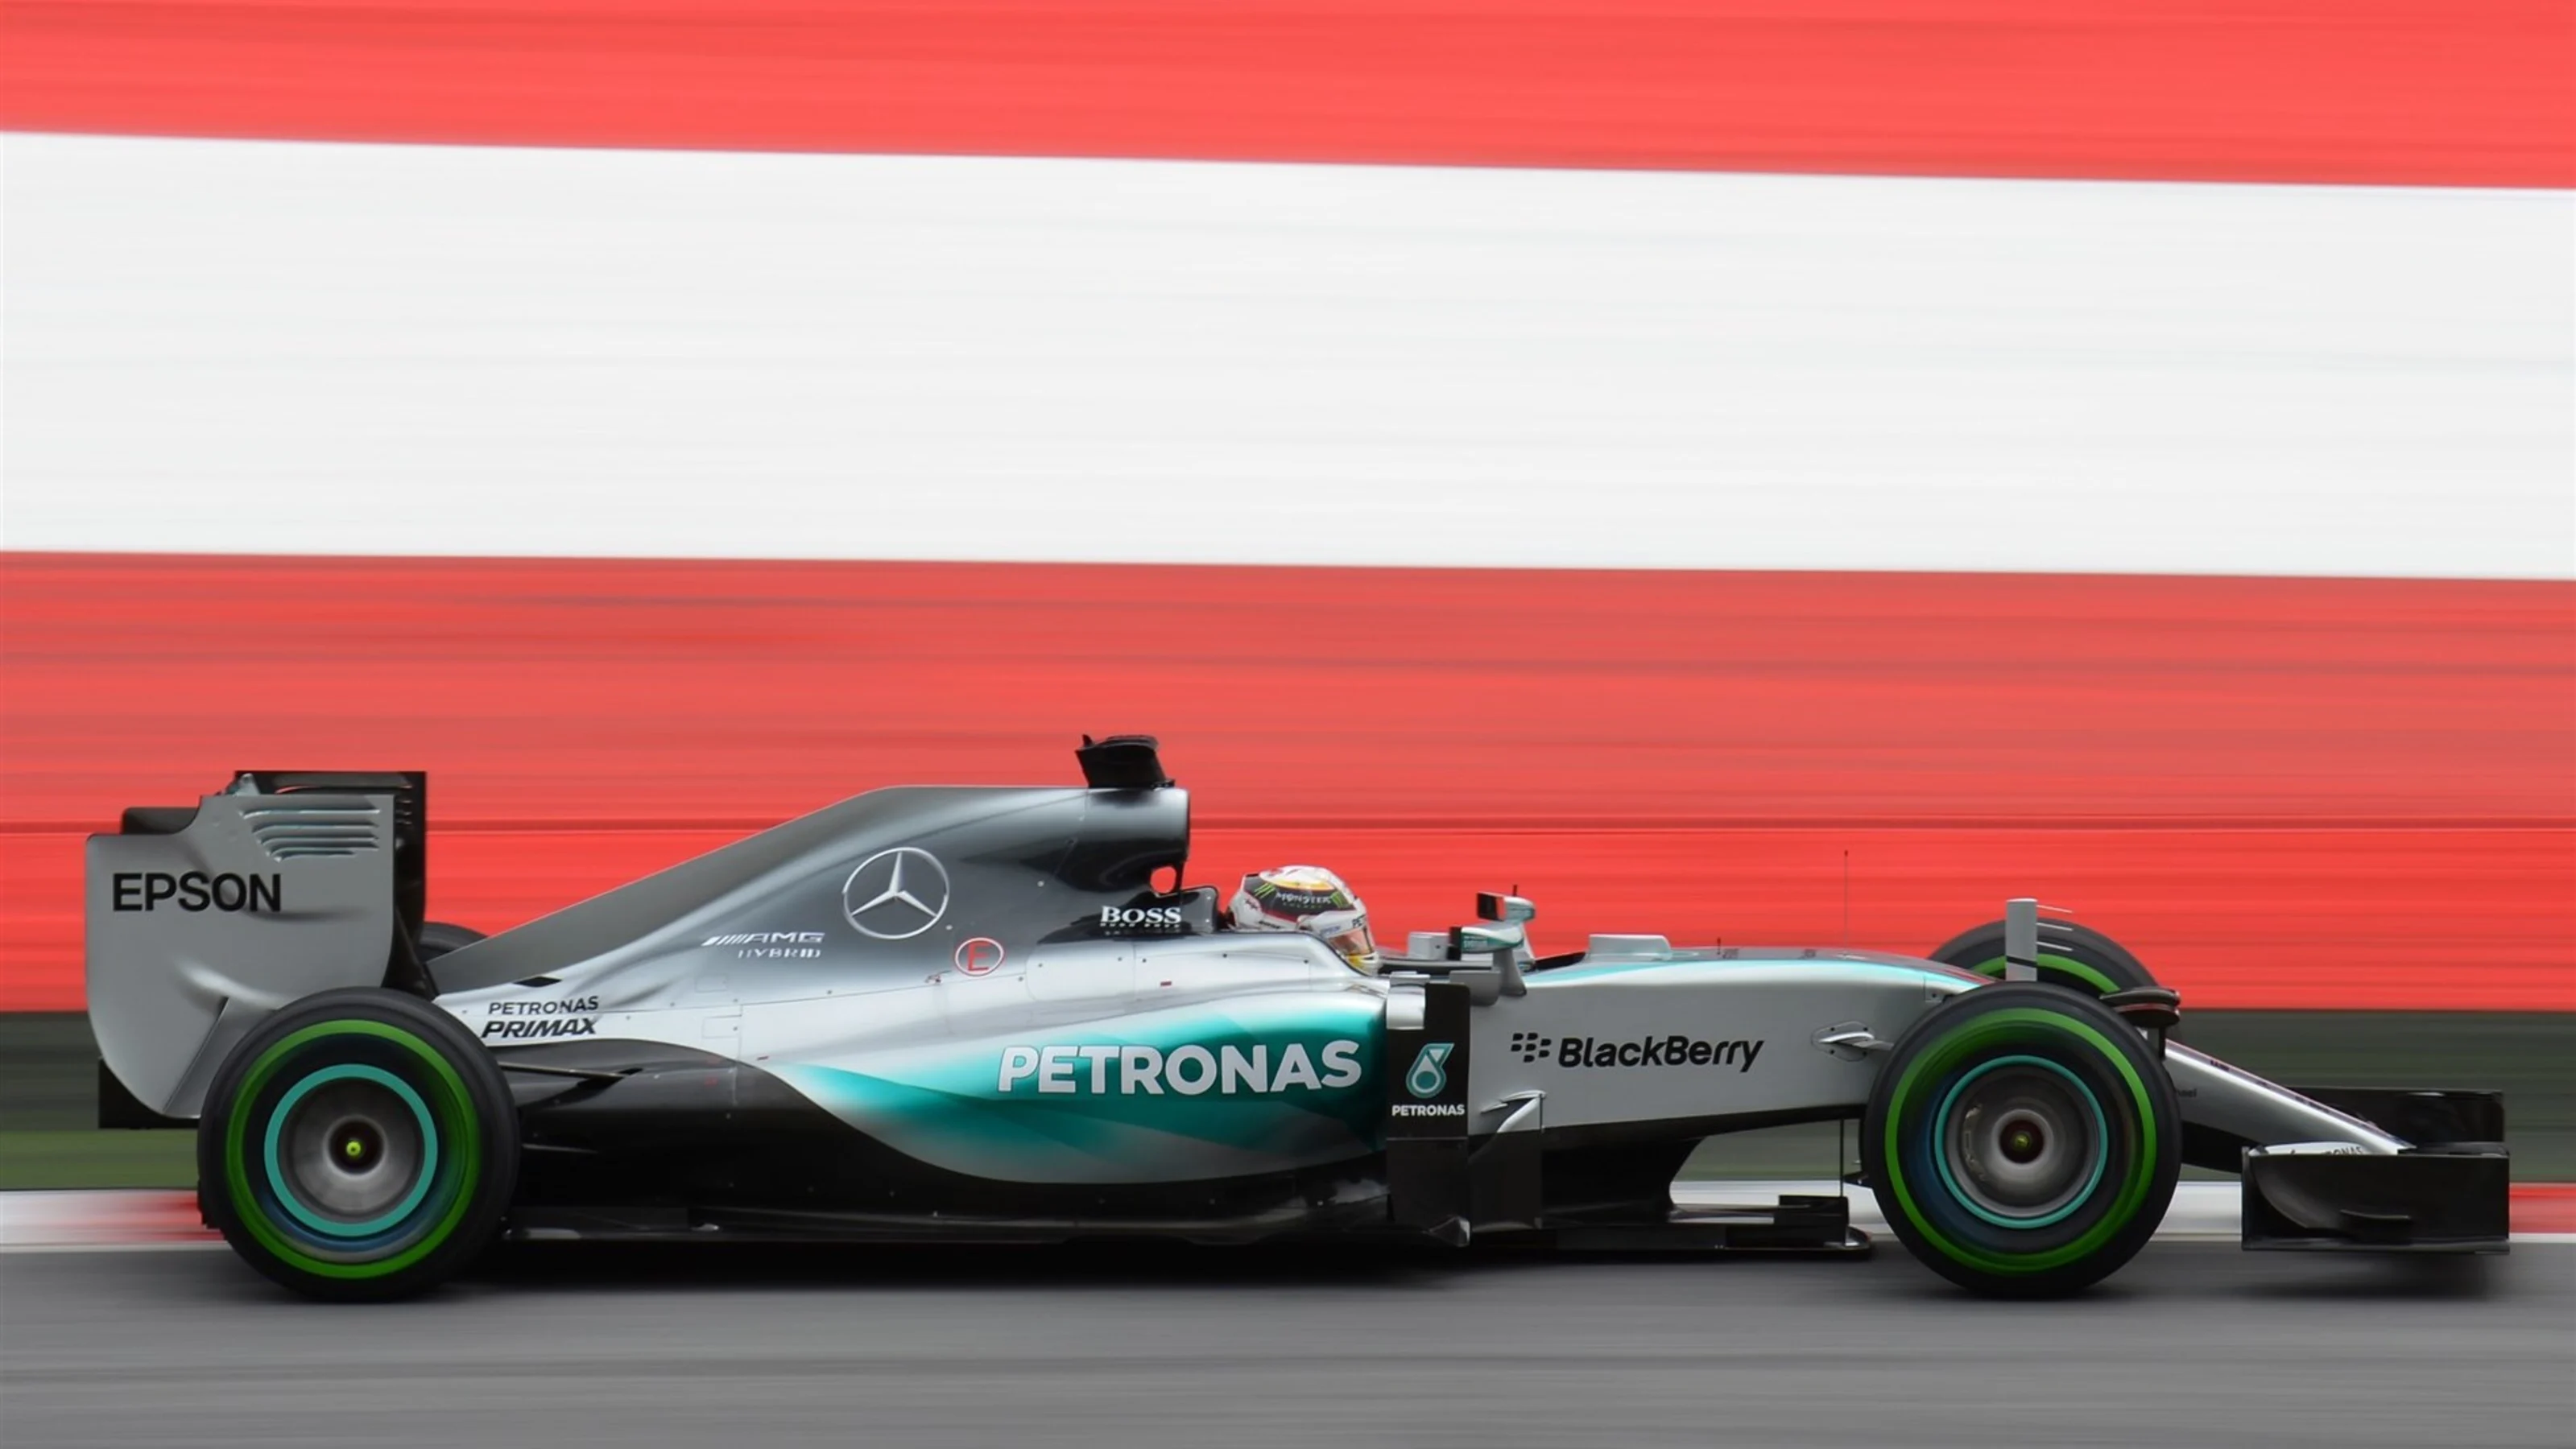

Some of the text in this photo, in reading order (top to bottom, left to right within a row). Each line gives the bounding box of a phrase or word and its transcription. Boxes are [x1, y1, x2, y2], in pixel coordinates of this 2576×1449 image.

[113, 870, 281, 913] EPSON
[1100, 905, 1182, 923] BOSS
[742, 931, 825, 944] AMG
[967, 940, 991, 971] E
[488, 995, 599, 1015] PETRONAS
[481, 1018, 597, 1038] PRIMAX
[1558, 1035, 1765, 1073] BlackBerry
[997, 1039, 1362, 1096] PETRONAS
[1391, 1104, 1466, 1117] PETRONAS
